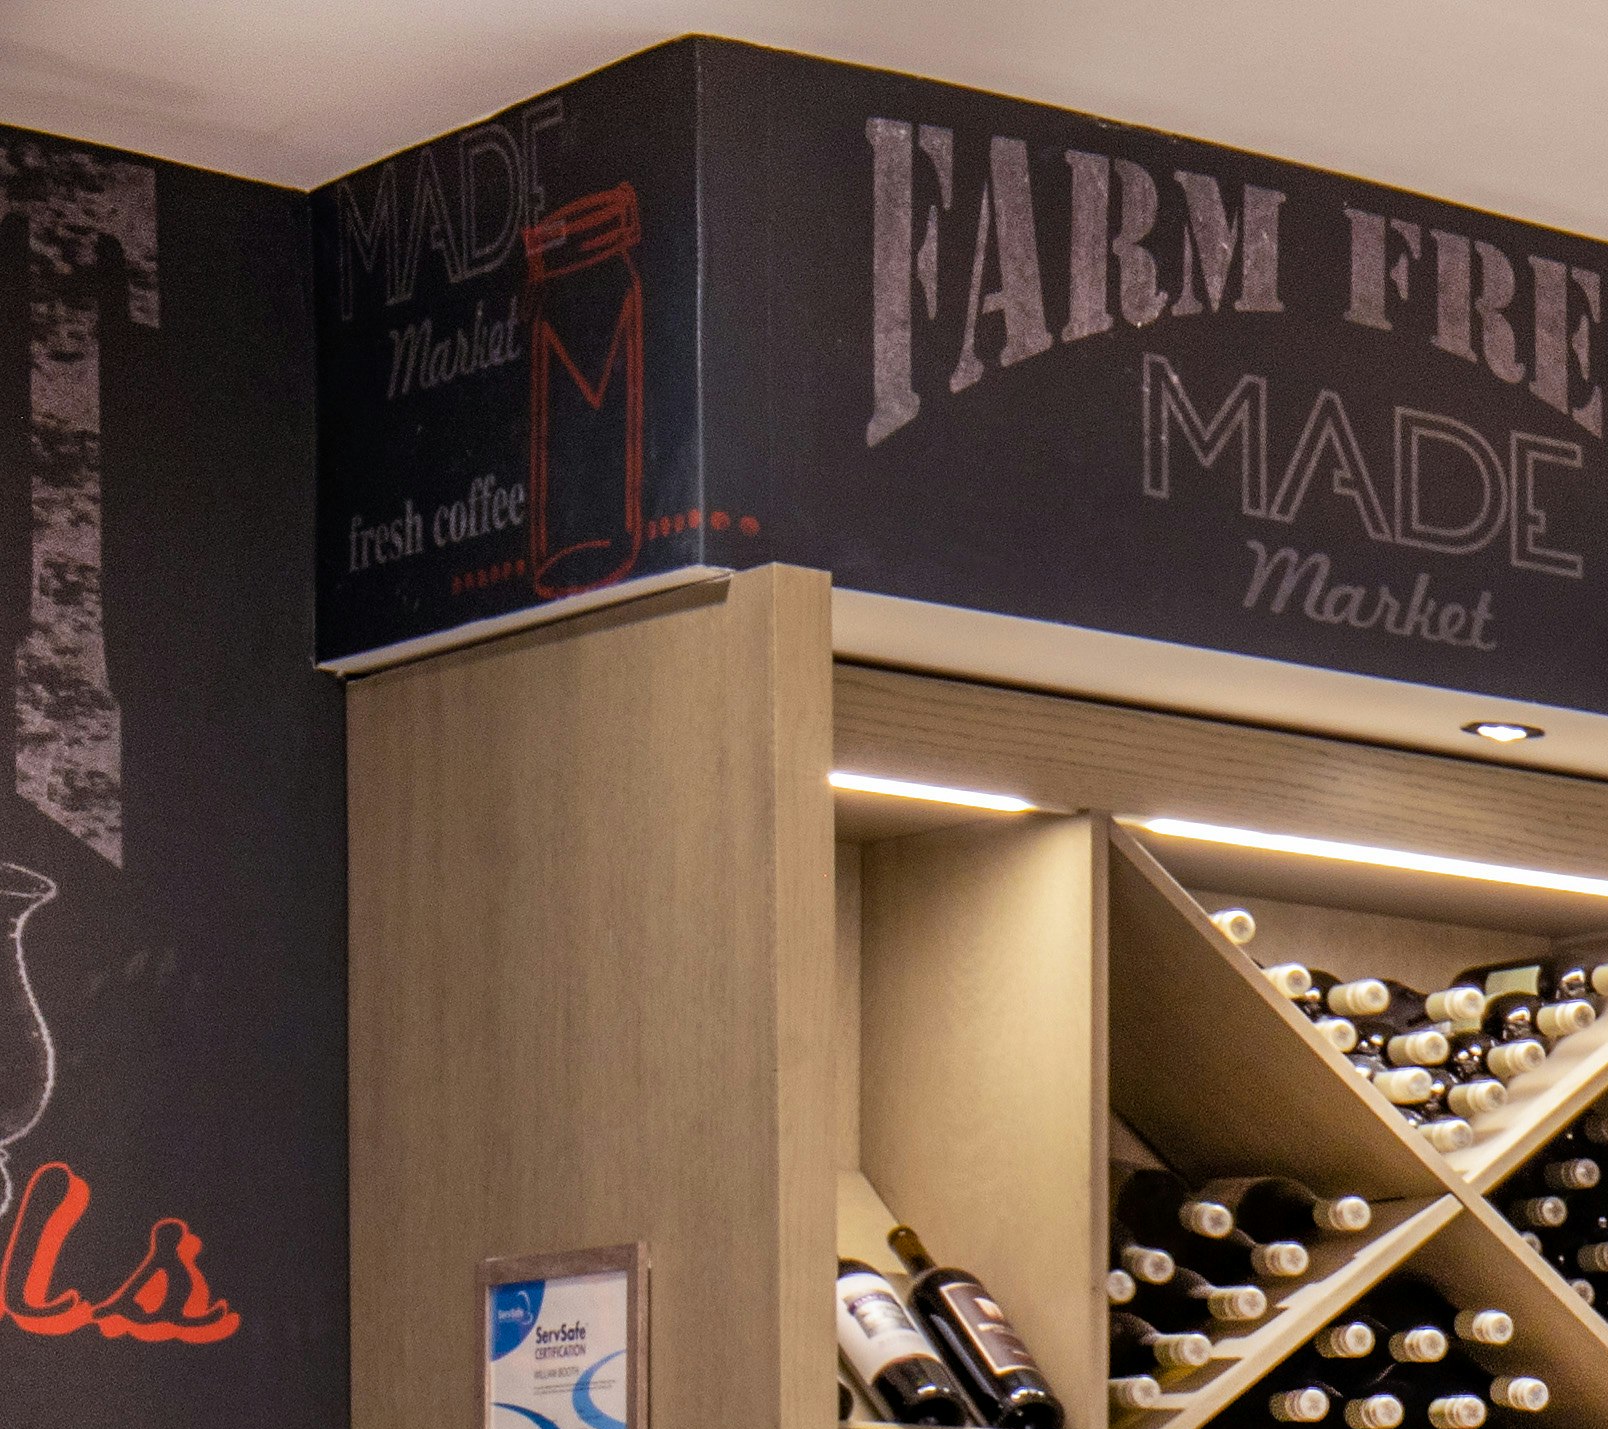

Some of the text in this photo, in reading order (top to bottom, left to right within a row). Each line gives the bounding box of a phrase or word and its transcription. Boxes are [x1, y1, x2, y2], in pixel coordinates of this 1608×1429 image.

[335, 100, 572, 322] MADE
[865, 115, 1287, 448] FARM
[385, 296, 524, 399] Market
[1142, 351, 1584, 579] MADE
[347, 473, 528, 575] fresh coffee
[1245, 537, 1499, 651] Market
[535, 1320, 587, 1344] ServSafe
[535, 1344, 587, 1360] CERTIFICATION
